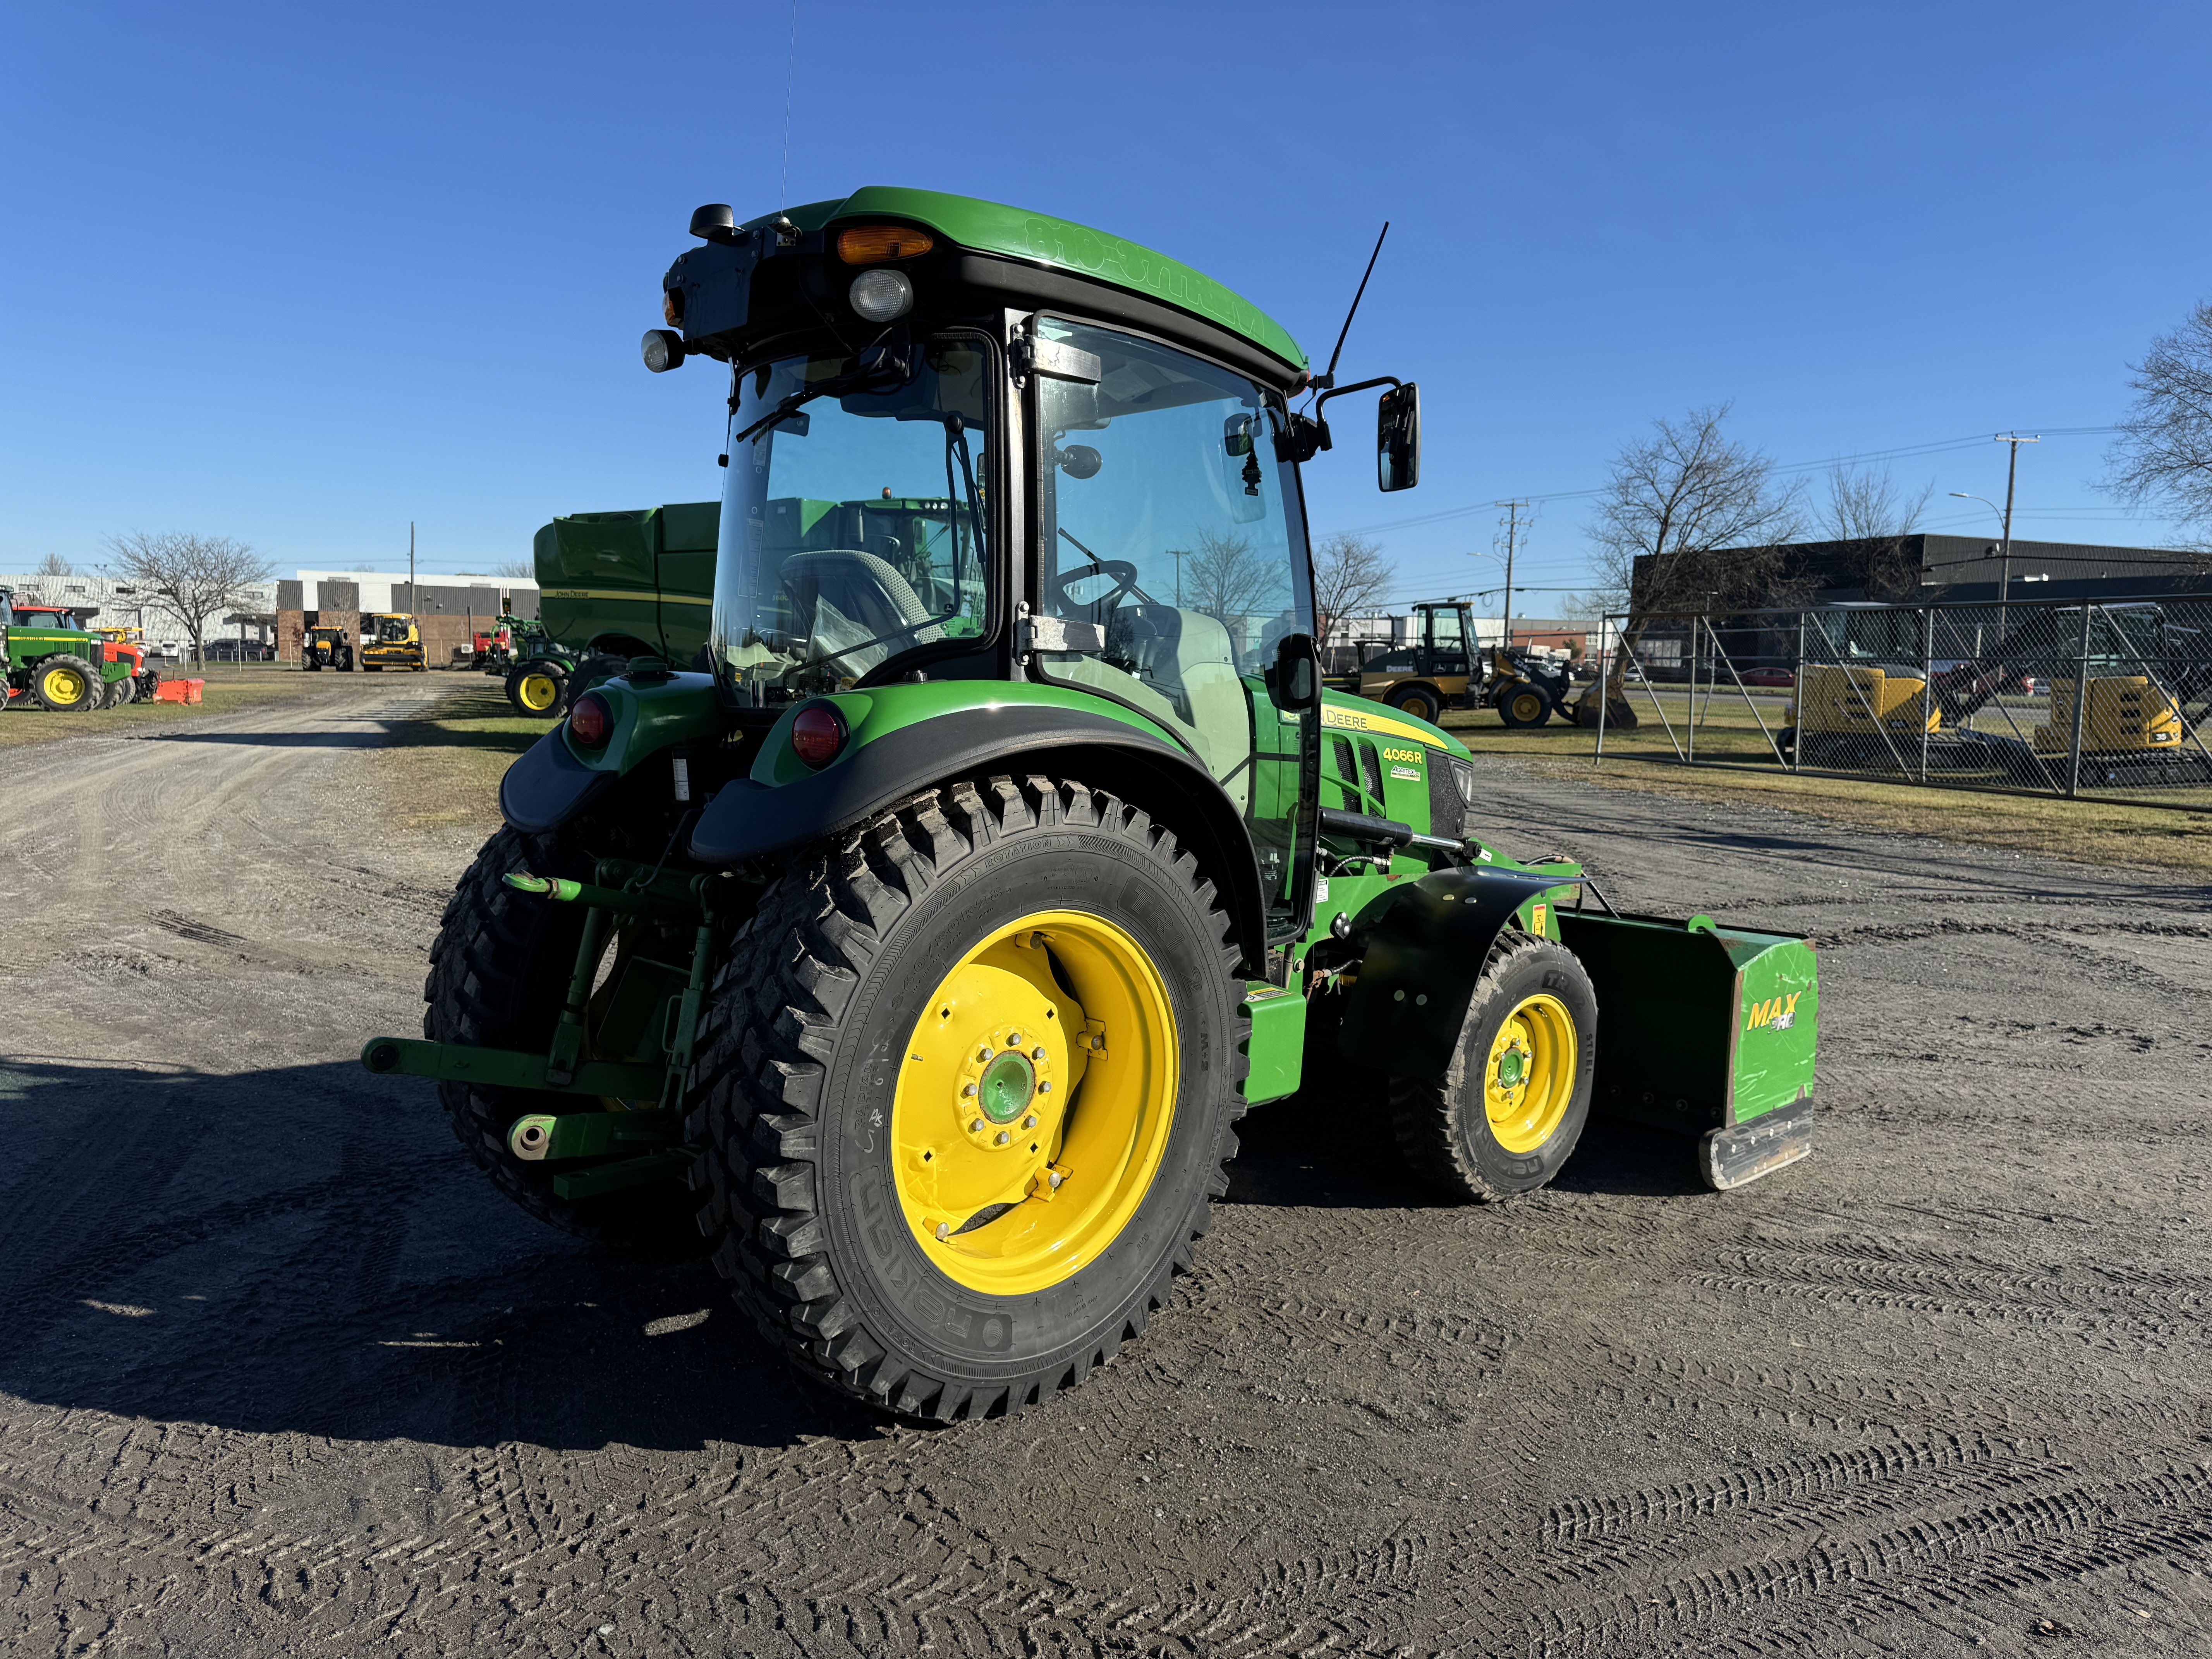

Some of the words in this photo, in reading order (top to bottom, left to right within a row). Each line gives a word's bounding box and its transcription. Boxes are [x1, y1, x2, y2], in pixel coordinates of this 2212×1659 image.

[570, 590, 589, 598] DEERE
[1326, 709, 1367, 728] DEERE
[1383, 747, 1422, 764] 4066R
[1392, 766, 1414, 774] AGRITEX
[984, 835, 1053, 871] ROTATION
[1126, 883, 1186, 955] TRI
[1179, 958, 1205, 1000] 2
[1747, 991, 1802, 1031] MAX
[1584, 1030, 1593, 1077] STEEL
[854, 1063, 872, 1130] RADIAL
[863, 1293, 919, 1357] ROTATION
